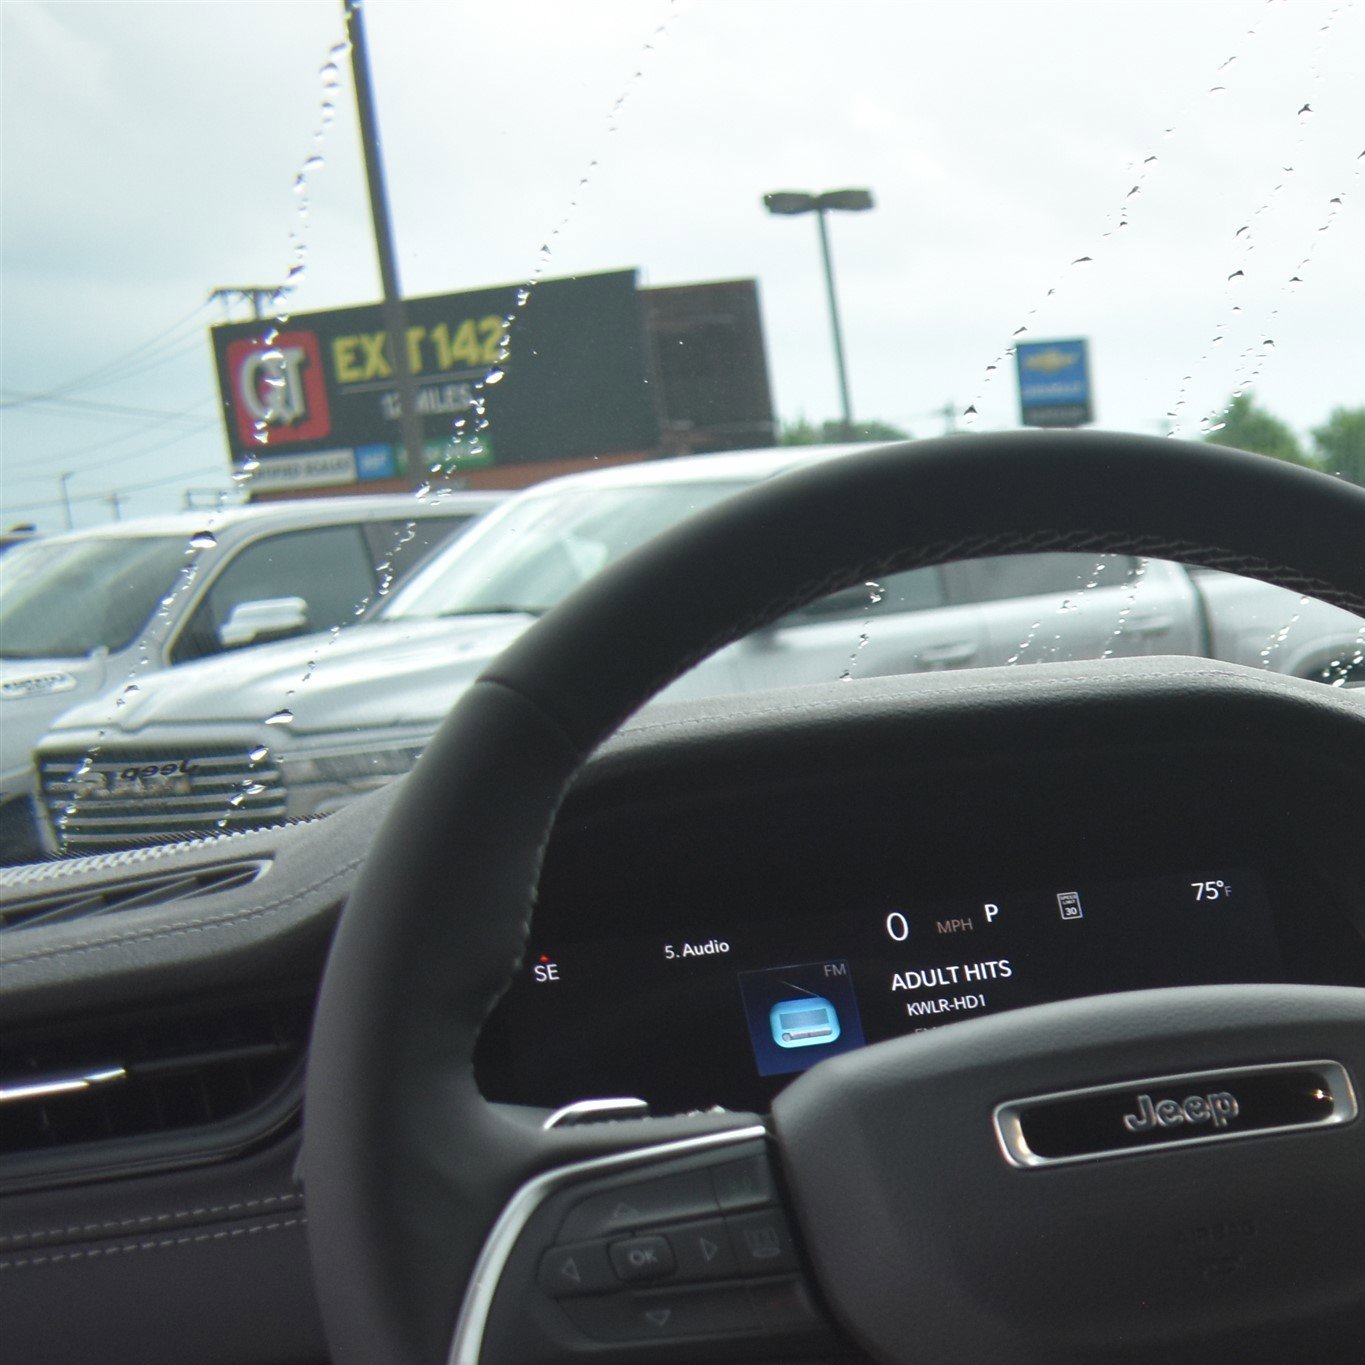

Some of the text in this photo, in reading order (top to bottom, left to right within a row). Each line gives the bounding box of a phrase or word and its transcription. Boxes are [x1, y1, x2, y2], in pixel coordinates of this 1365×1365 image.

[331, 314, 506, 383] EXT 142
[984, 903, 999, 923] P
[1065, 907, 1078, 916] 30
[886, 912, 974, 942] 0 MPH
[664, 939, 730, 960] 5. Audio
[534, 963, 561, 982] SE
[823, 963, 847, 977] FM
[891, 959, 1013, 992] ADULT HITS
[906, 993, 987, 1017] KWLR-HD1
[1122, 1091, 1240, 1133] Jeep
[627, 1248, 658, 1267] OK
